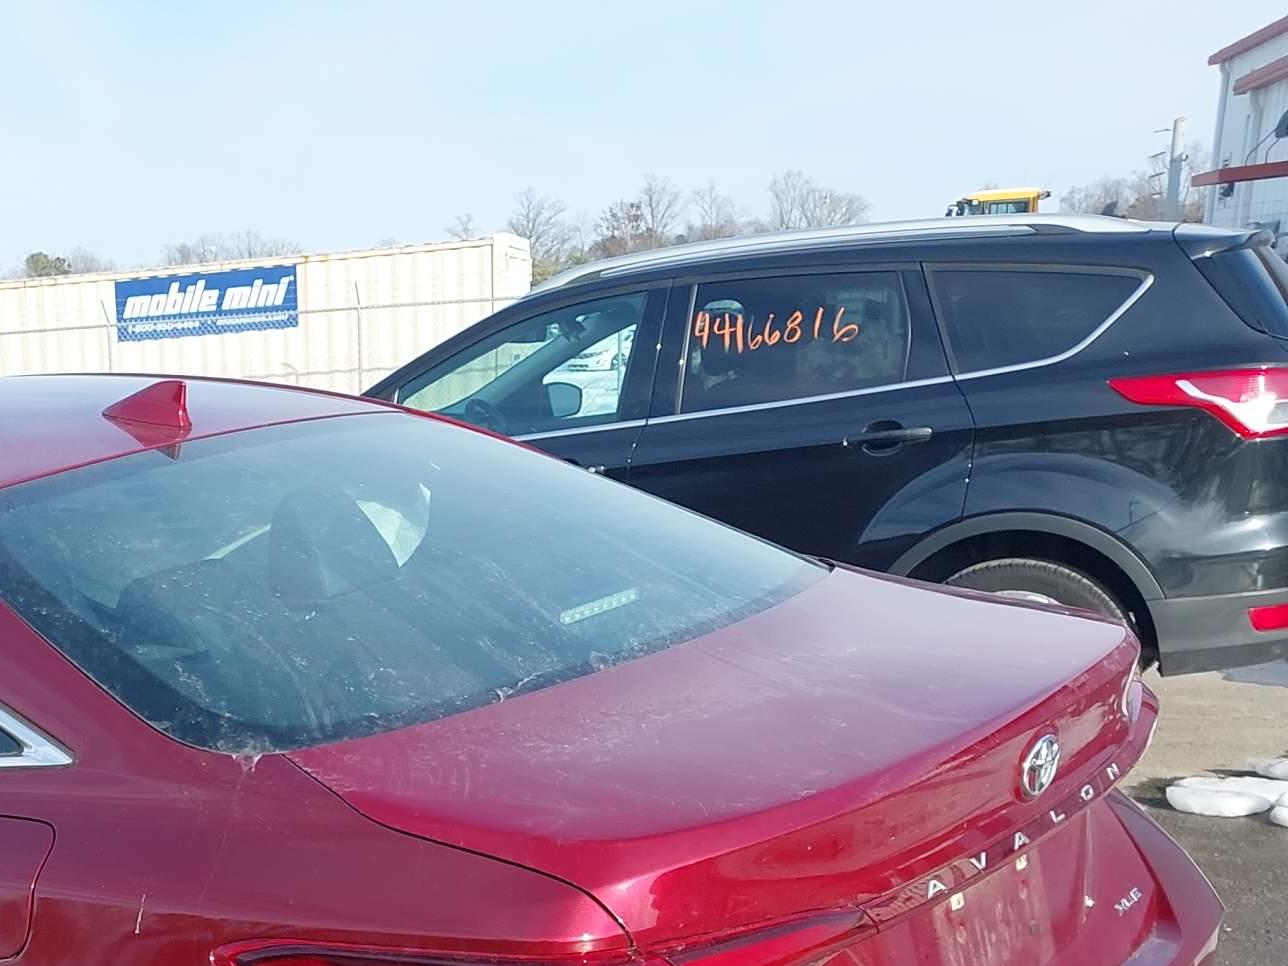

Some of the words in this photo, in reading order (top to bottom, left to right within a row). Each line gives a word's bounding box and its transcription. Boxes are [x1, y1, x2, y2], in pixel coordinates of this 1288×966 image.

[123, 279, 220, 319] mobile
[221, 276, 292, 311] mini
[927, 762, 1122, 899] AVALON
[1114, 887, 1142, 917] XLE
